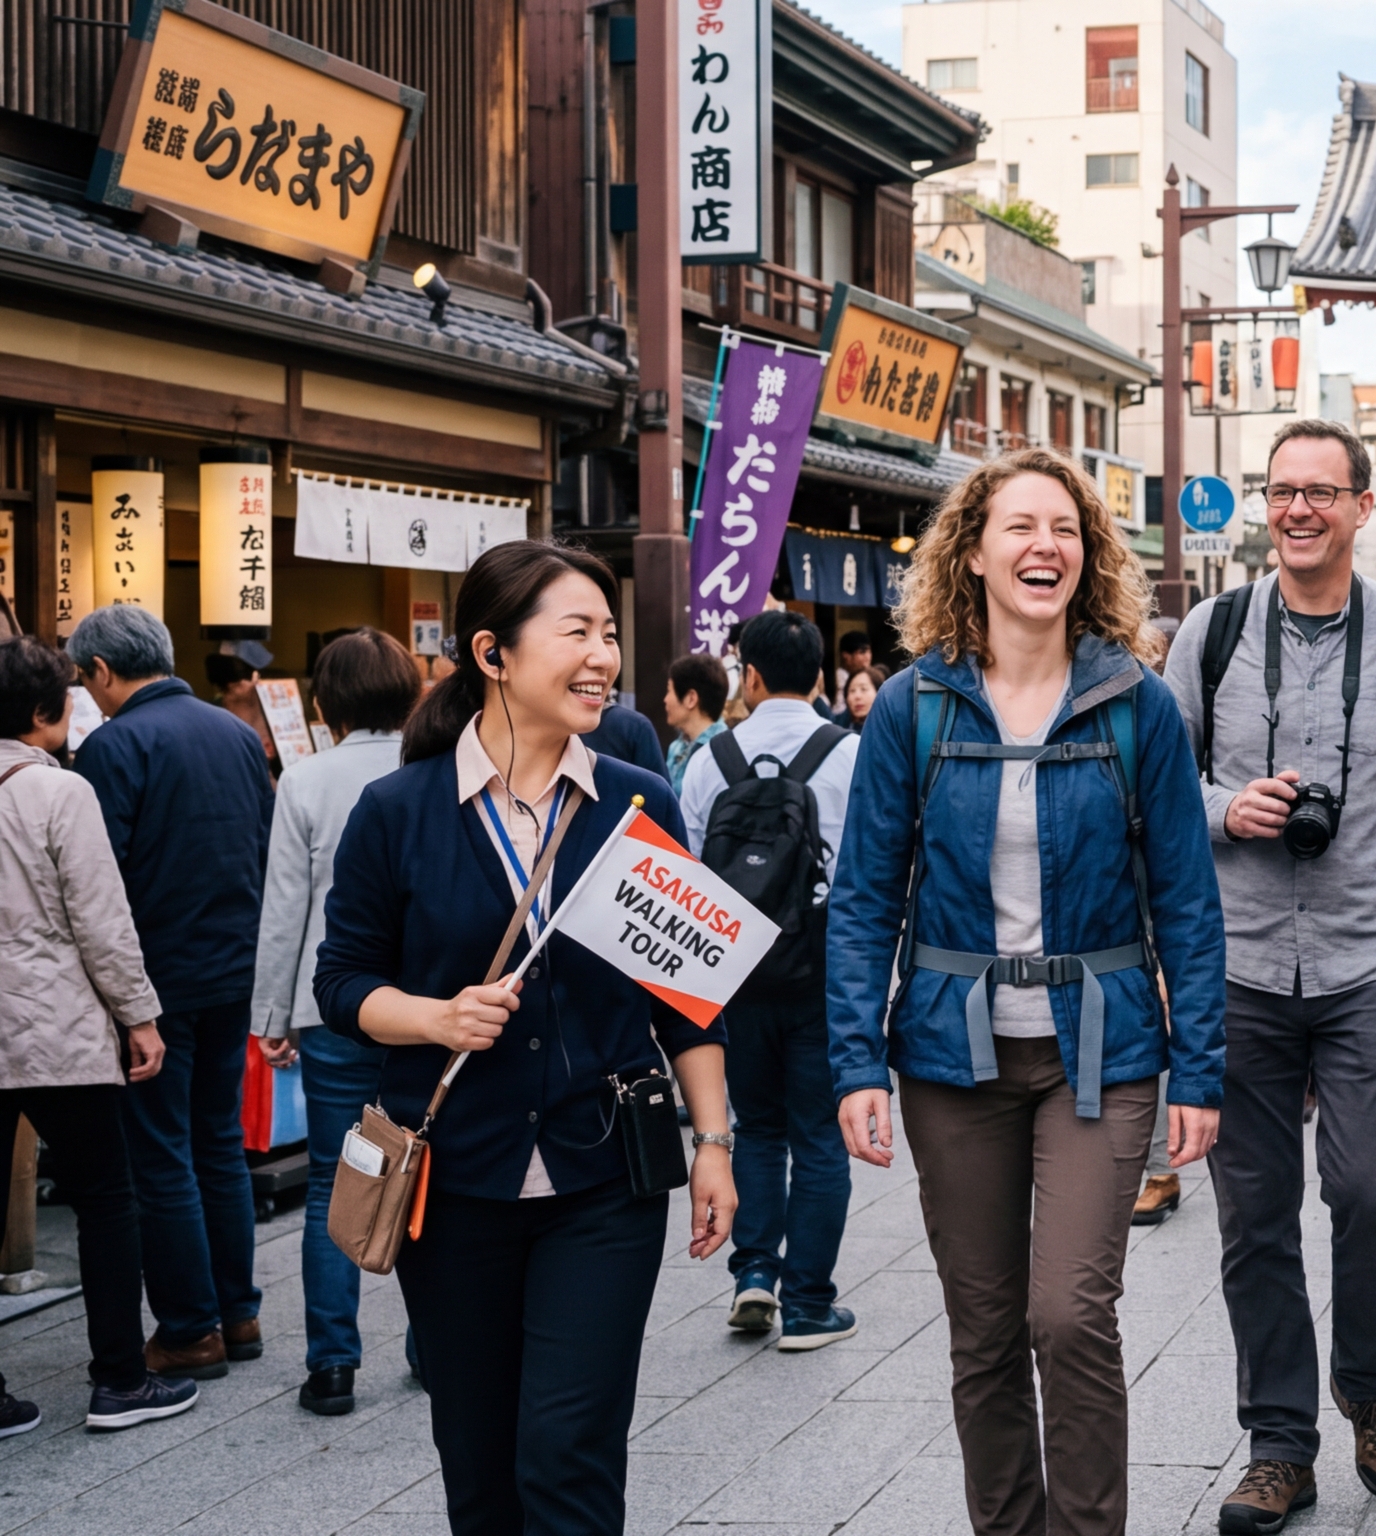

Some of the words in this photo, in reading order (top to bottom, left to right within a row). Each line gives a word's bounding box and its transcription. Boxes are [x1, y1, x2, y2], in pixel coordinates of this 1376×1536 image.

[614, 879, 725, 968] WALKING
[631, 856, 742, 944] ASAKUSA
[618, 921, 684, 978] TOUR
